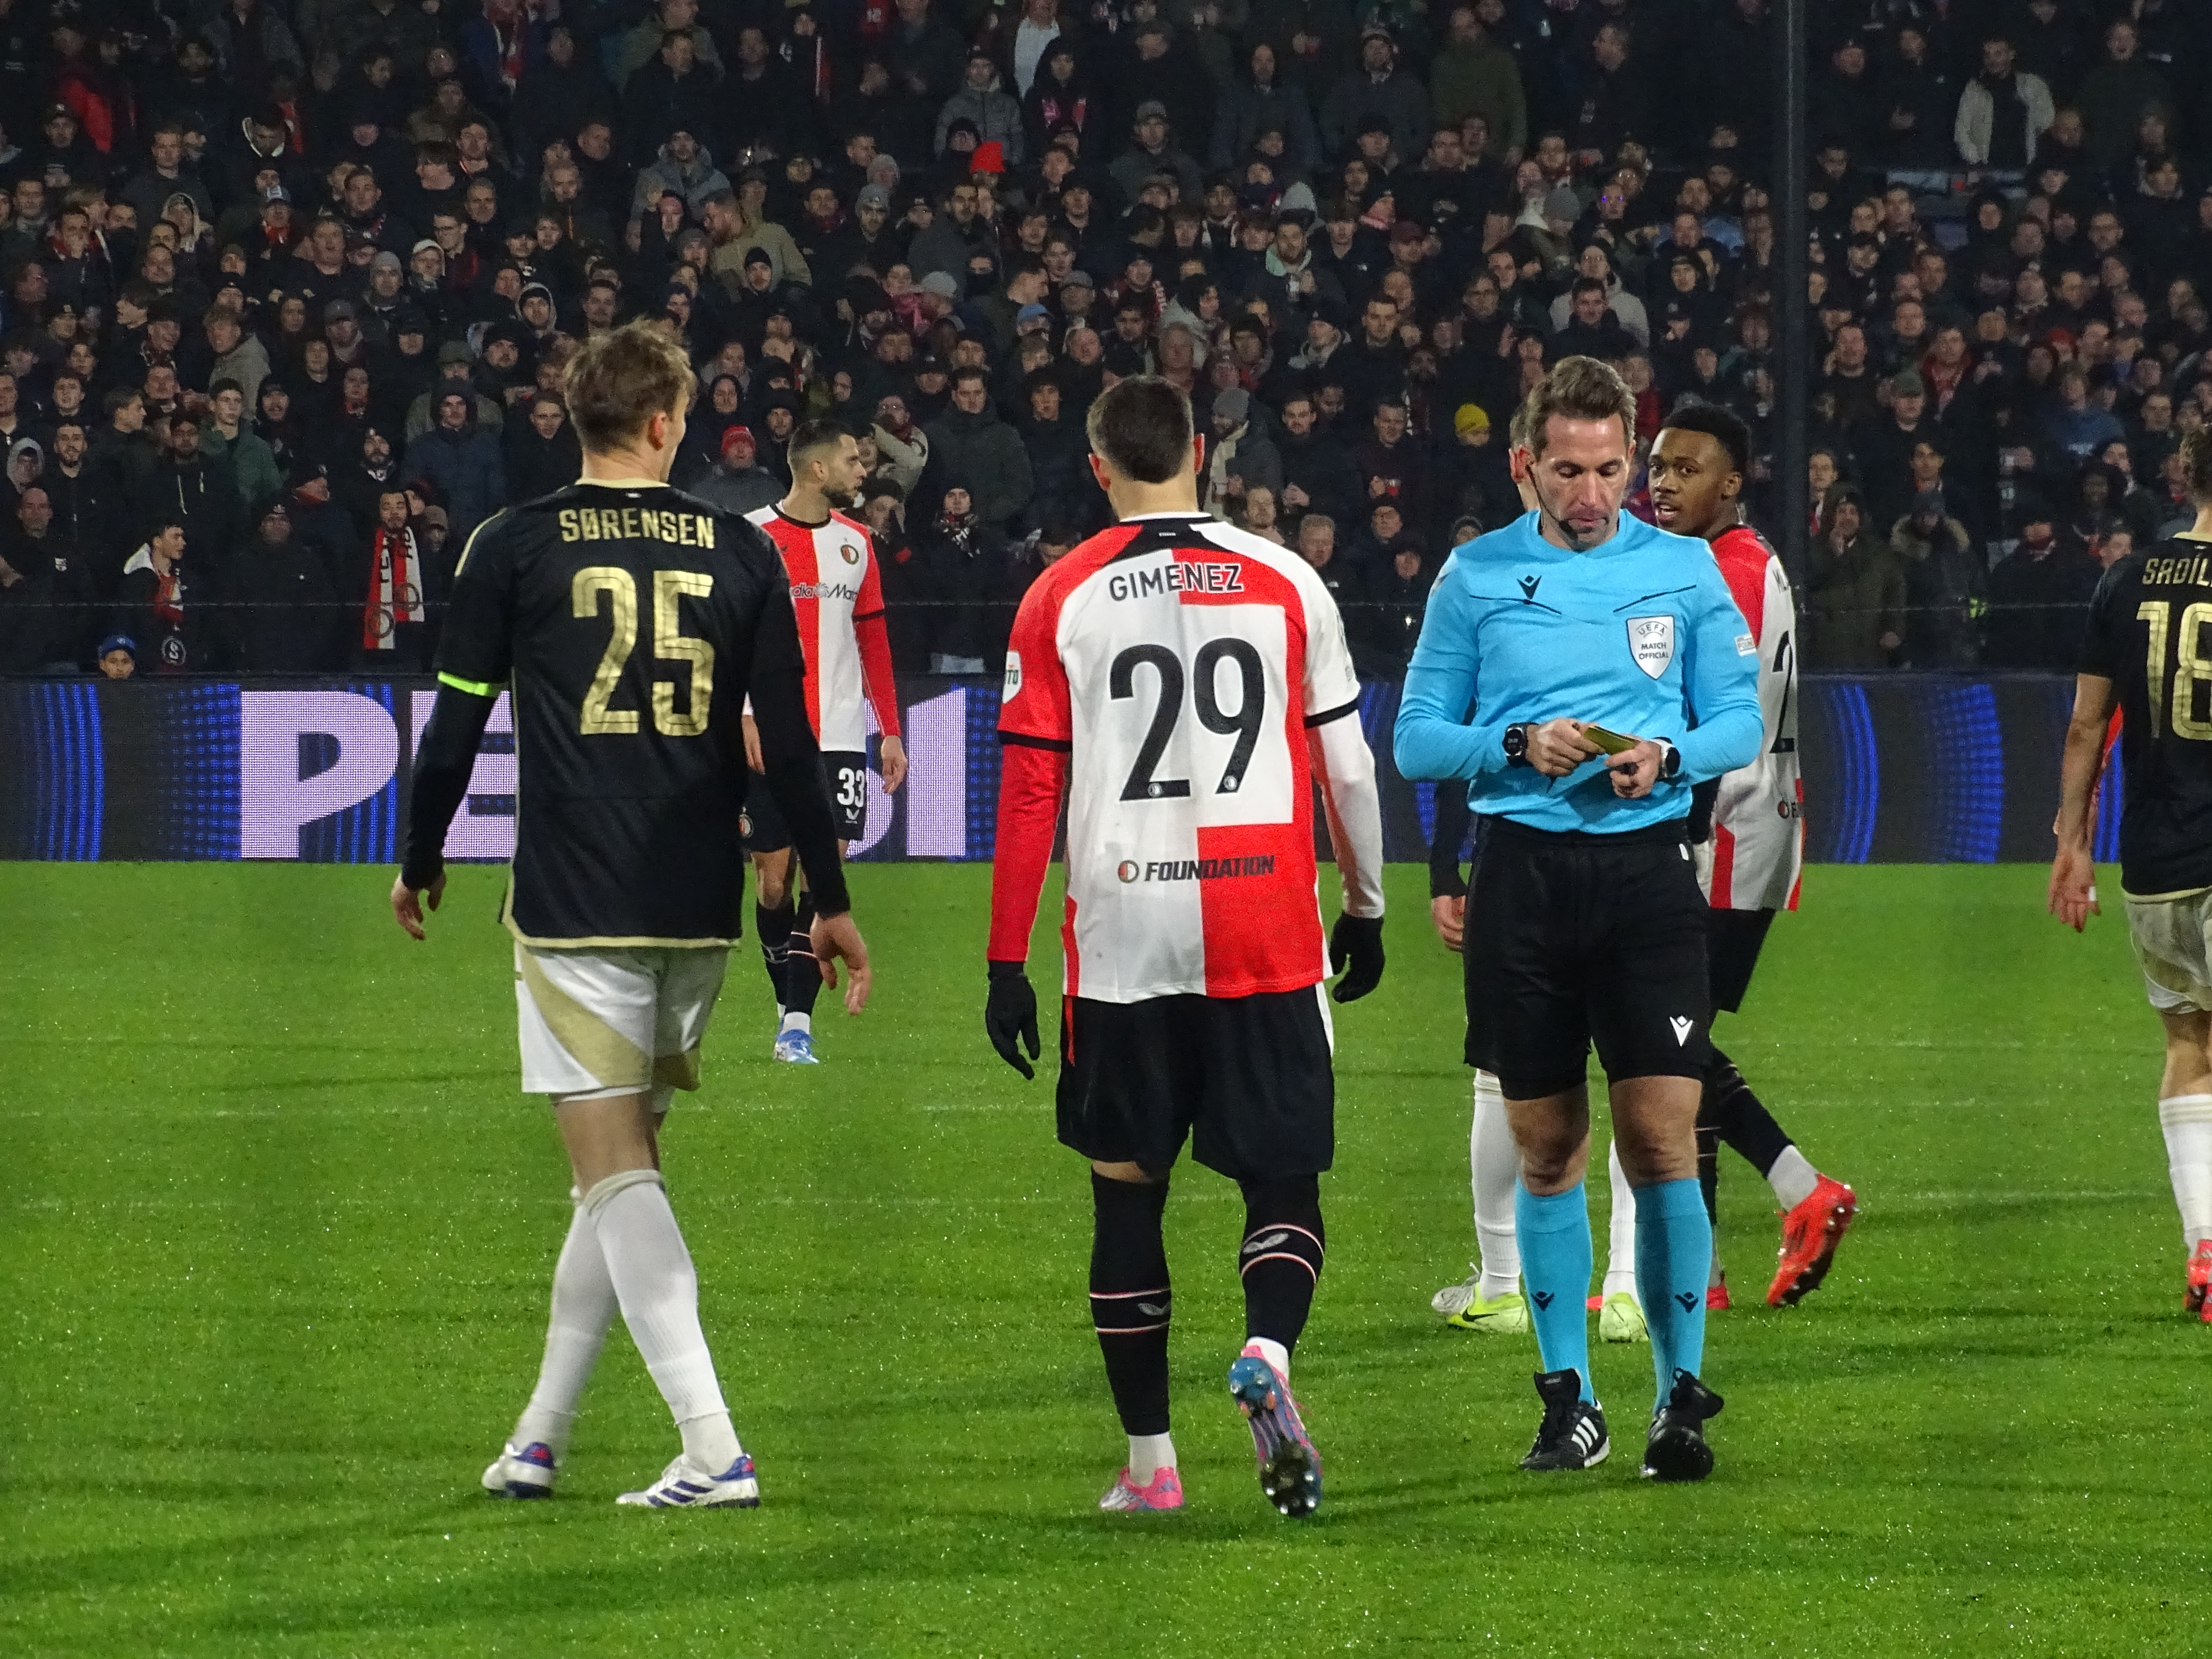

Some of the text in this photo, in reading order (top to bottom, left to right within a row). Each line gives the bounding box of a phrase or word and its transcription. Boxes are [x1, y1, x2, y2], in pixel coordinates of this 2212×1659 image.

[559, 507, 715, 549] SØRENSEN
[1109, 562, 1244, 602] GIMENEZ
[2142, 552, 2212, 587] SADÍL
[1638, 623, 1665, 635] UEFA
[1641, 641, 1667, 651] MATCH
[571, 566, 715, 736] 25
[1638, 651, 1669, 660] OFFICIAL
[2136, 601, 2212, 741] 18
[1110, 637, 1265, 802] 29
[837, 767, 865, 808] 33
[1144, 855, 1275, 882] FOUNDATION
